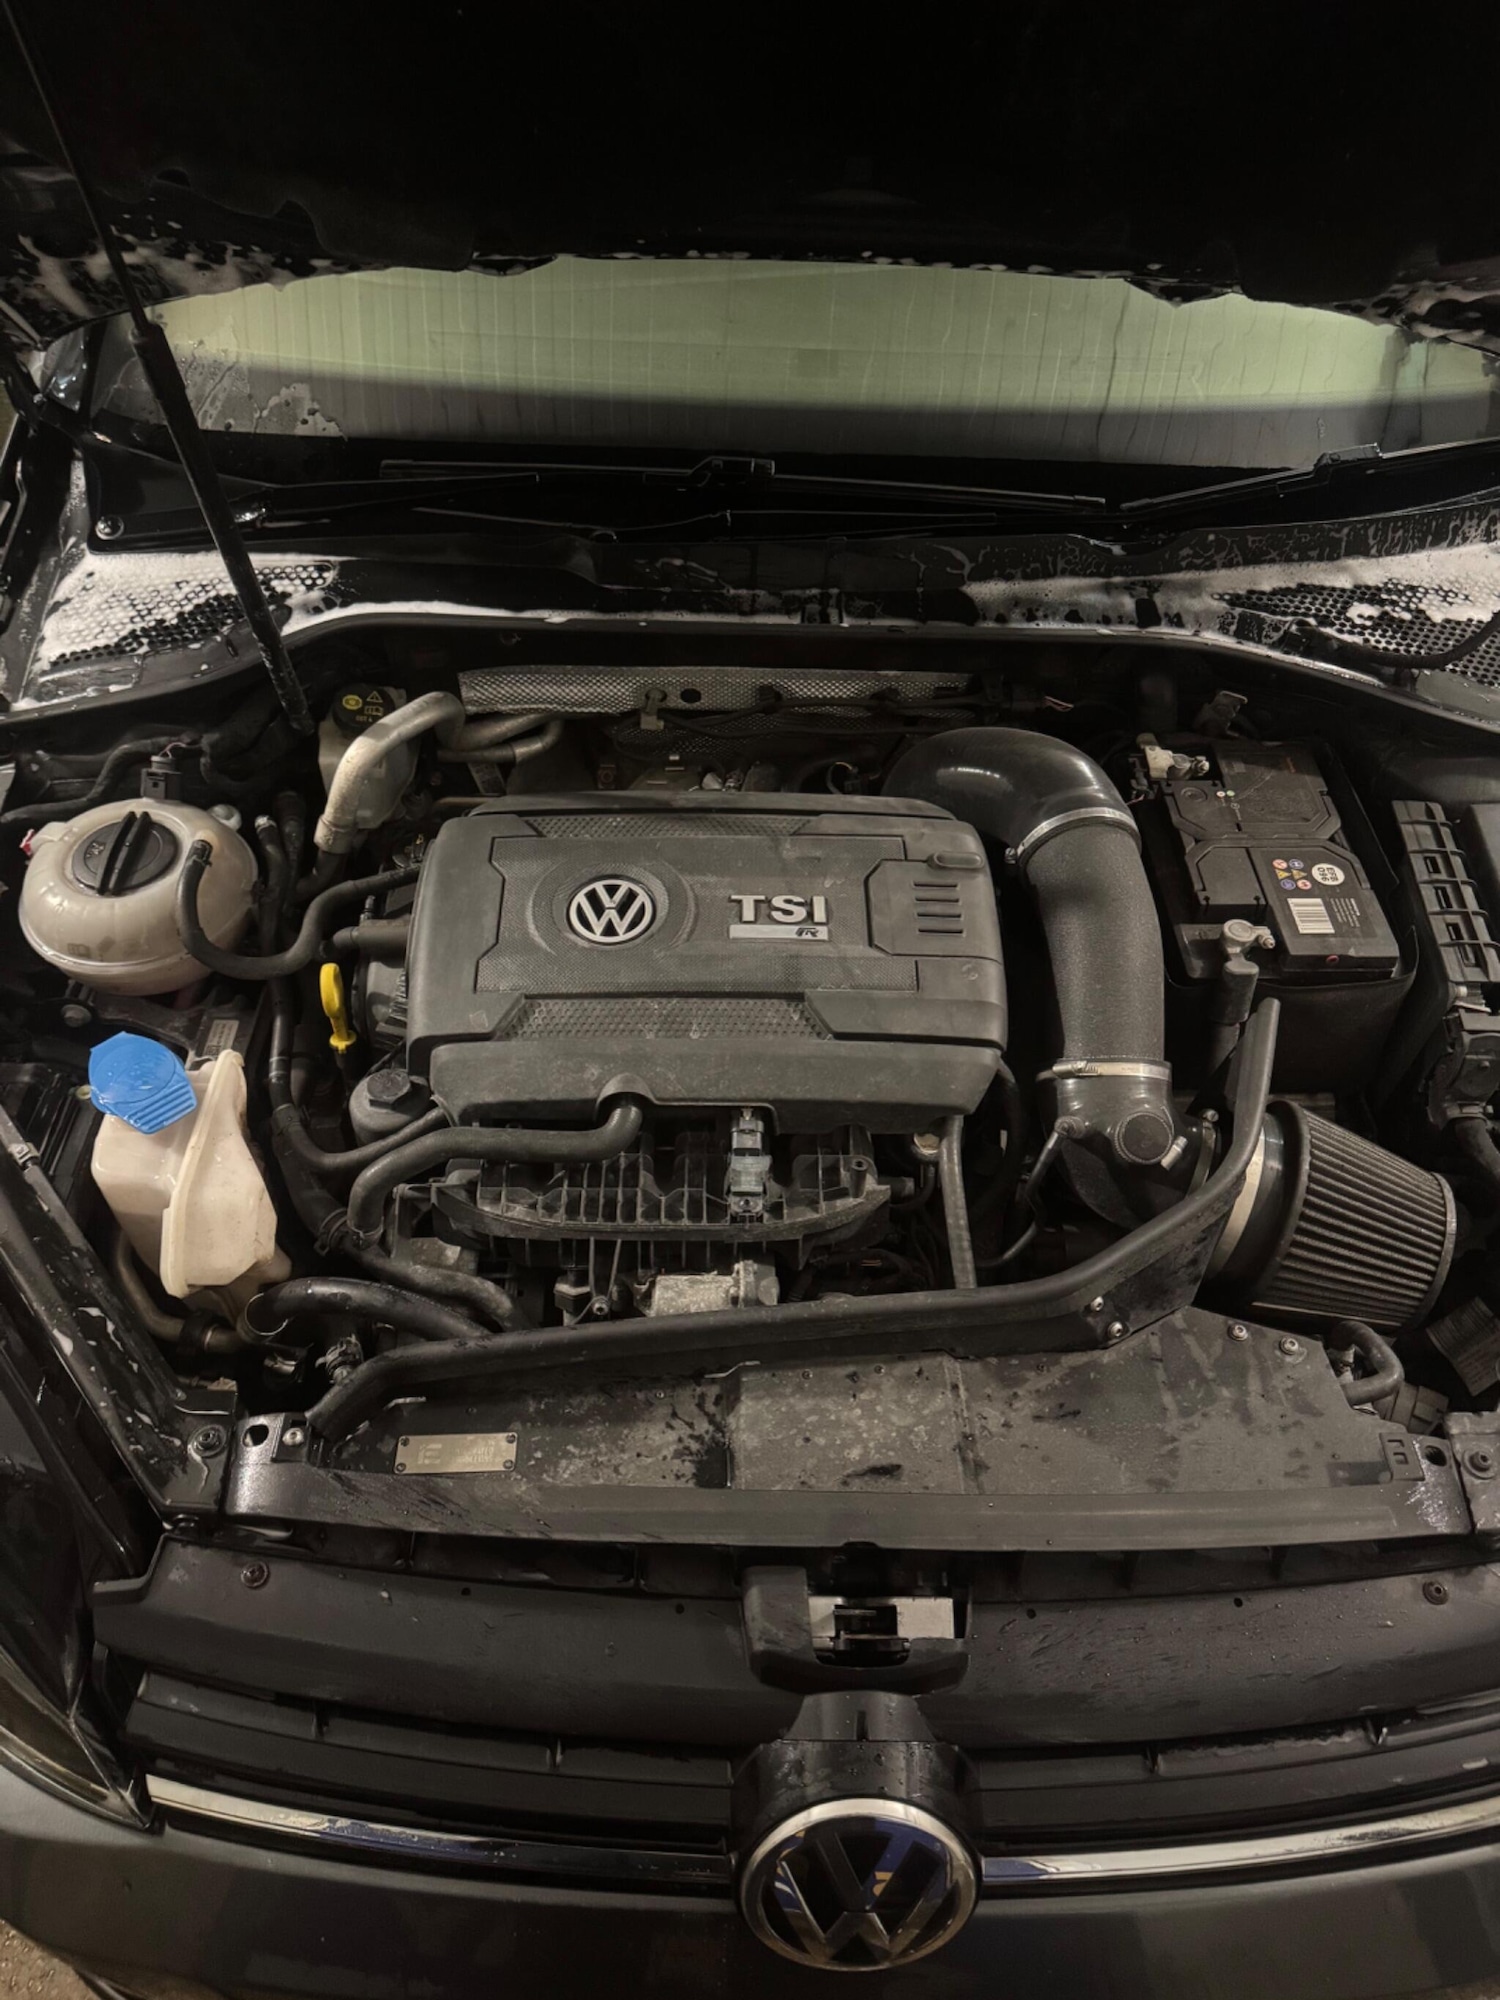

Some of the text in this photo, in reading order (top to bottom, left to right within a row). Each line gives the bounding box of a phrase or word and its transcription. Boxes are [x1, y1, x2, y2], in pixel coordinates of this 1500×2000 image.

[569, 879, 653, 943] VW
[730, 894, 828, 924] TSI
[745, 1800, 973, 1970] VW
